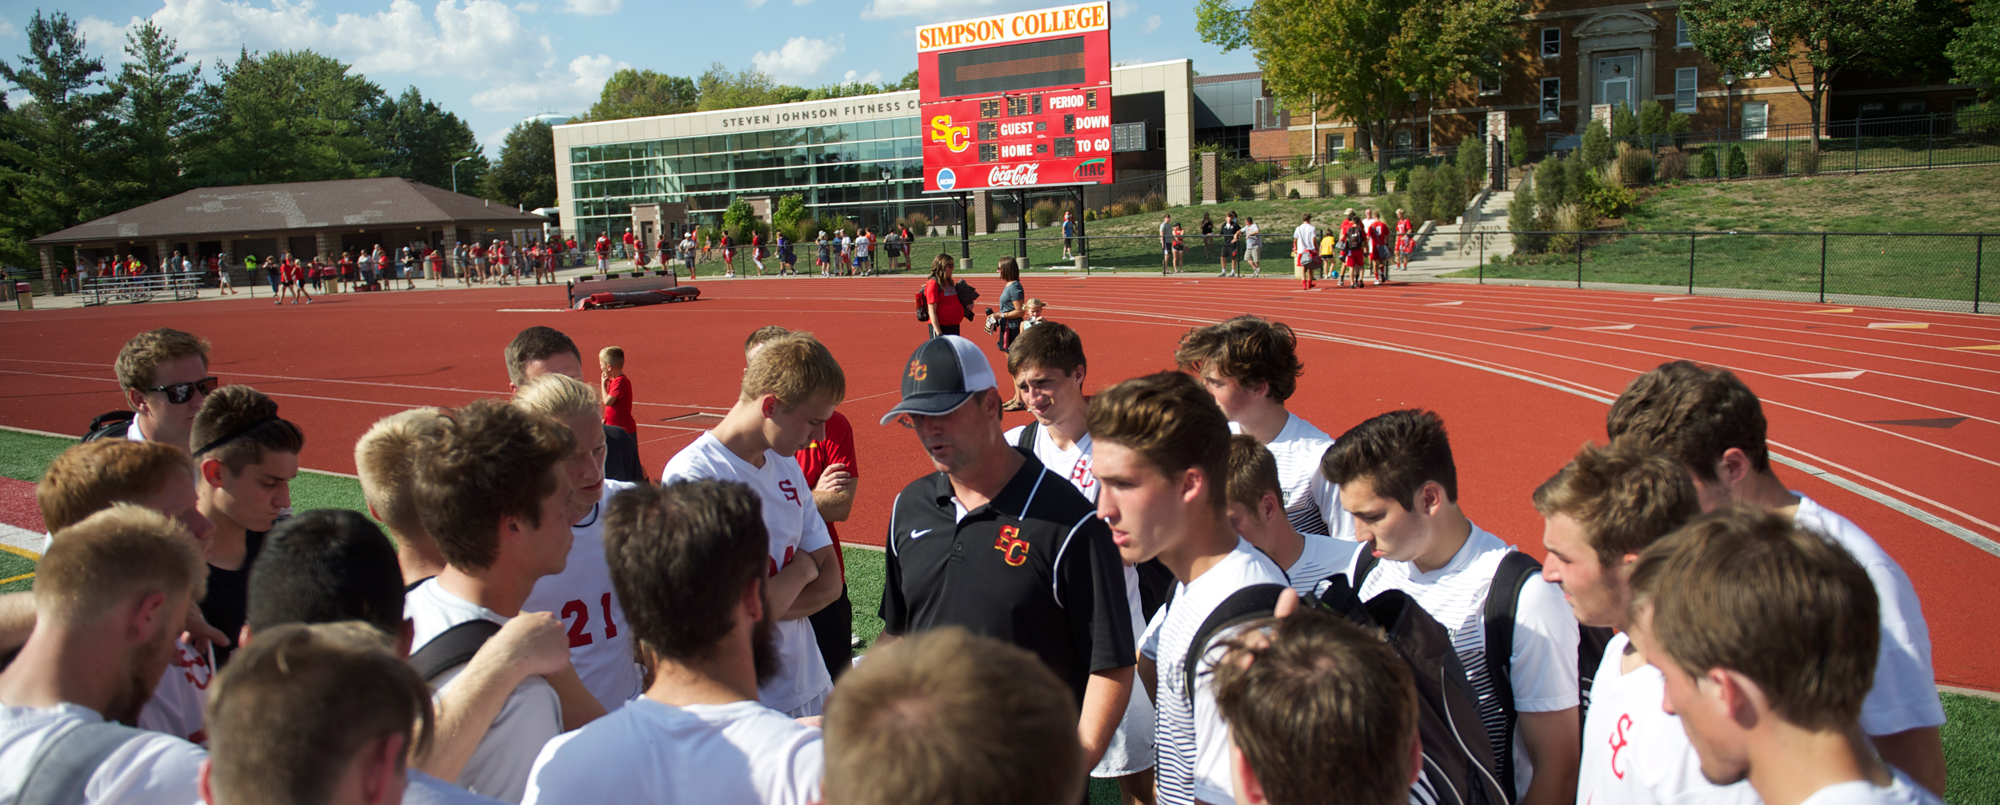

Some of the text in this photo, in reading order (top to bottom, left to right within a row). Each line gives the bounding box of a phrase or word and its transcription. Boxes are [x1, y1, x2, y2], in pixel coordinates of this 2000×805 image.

[919, 5, 1105, 49] SIMPSON COLLEGE
[1049, 95, 1084, 109] PERIOD
[1087, 90, 1097, 110] 2
[722, 114, 770, 127] STEVEN
[776, 108, 837, 124] JOHNSON
[844, 102, 901, 116] FITNESS
[1075, 115, 1109, 130] DOWN
[931, 114, 970, 153] SC
[1000, 122, 1034, 136] GUEST
[1001, 144, 1033, 158] HOME
[1076, 138, 1110, 152] TO GO
[1079, 163, 1105, 177] IIAC
[908, 359, 927, 381] SC
[994, 524, 1030, 567] SC
[561, 592, 618, 649] 21
